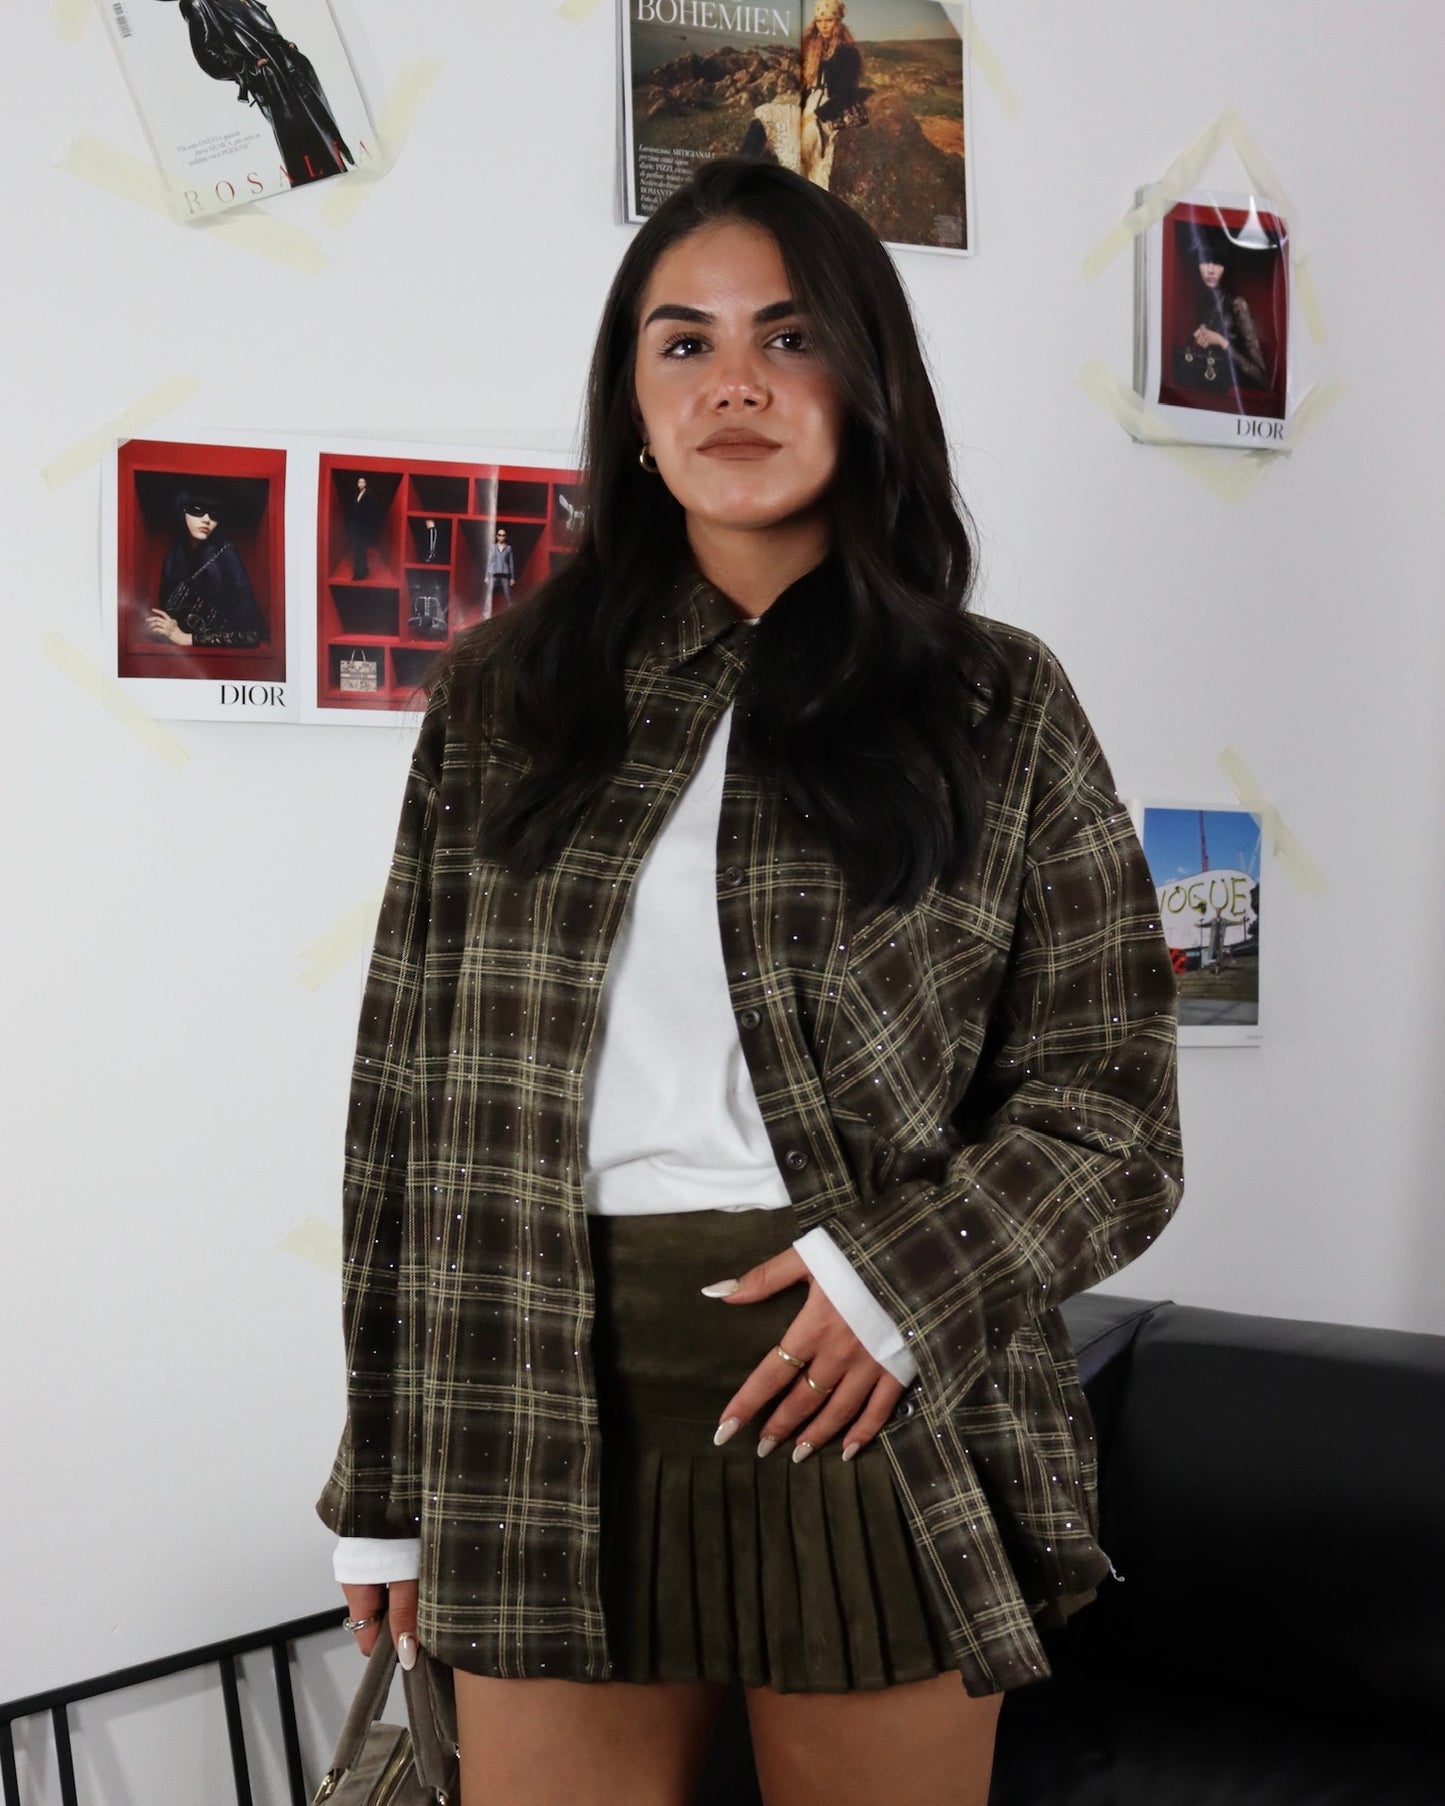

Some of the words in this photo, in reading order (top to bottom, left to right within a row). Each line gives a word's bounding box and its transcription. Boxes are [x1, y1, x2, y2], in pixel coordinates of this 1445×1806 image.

[638, 0, 791, 37] BOHEMIEN
[1236, 418, 1284, 441] DIOR
[219, 684, 287, 708] DIOR
